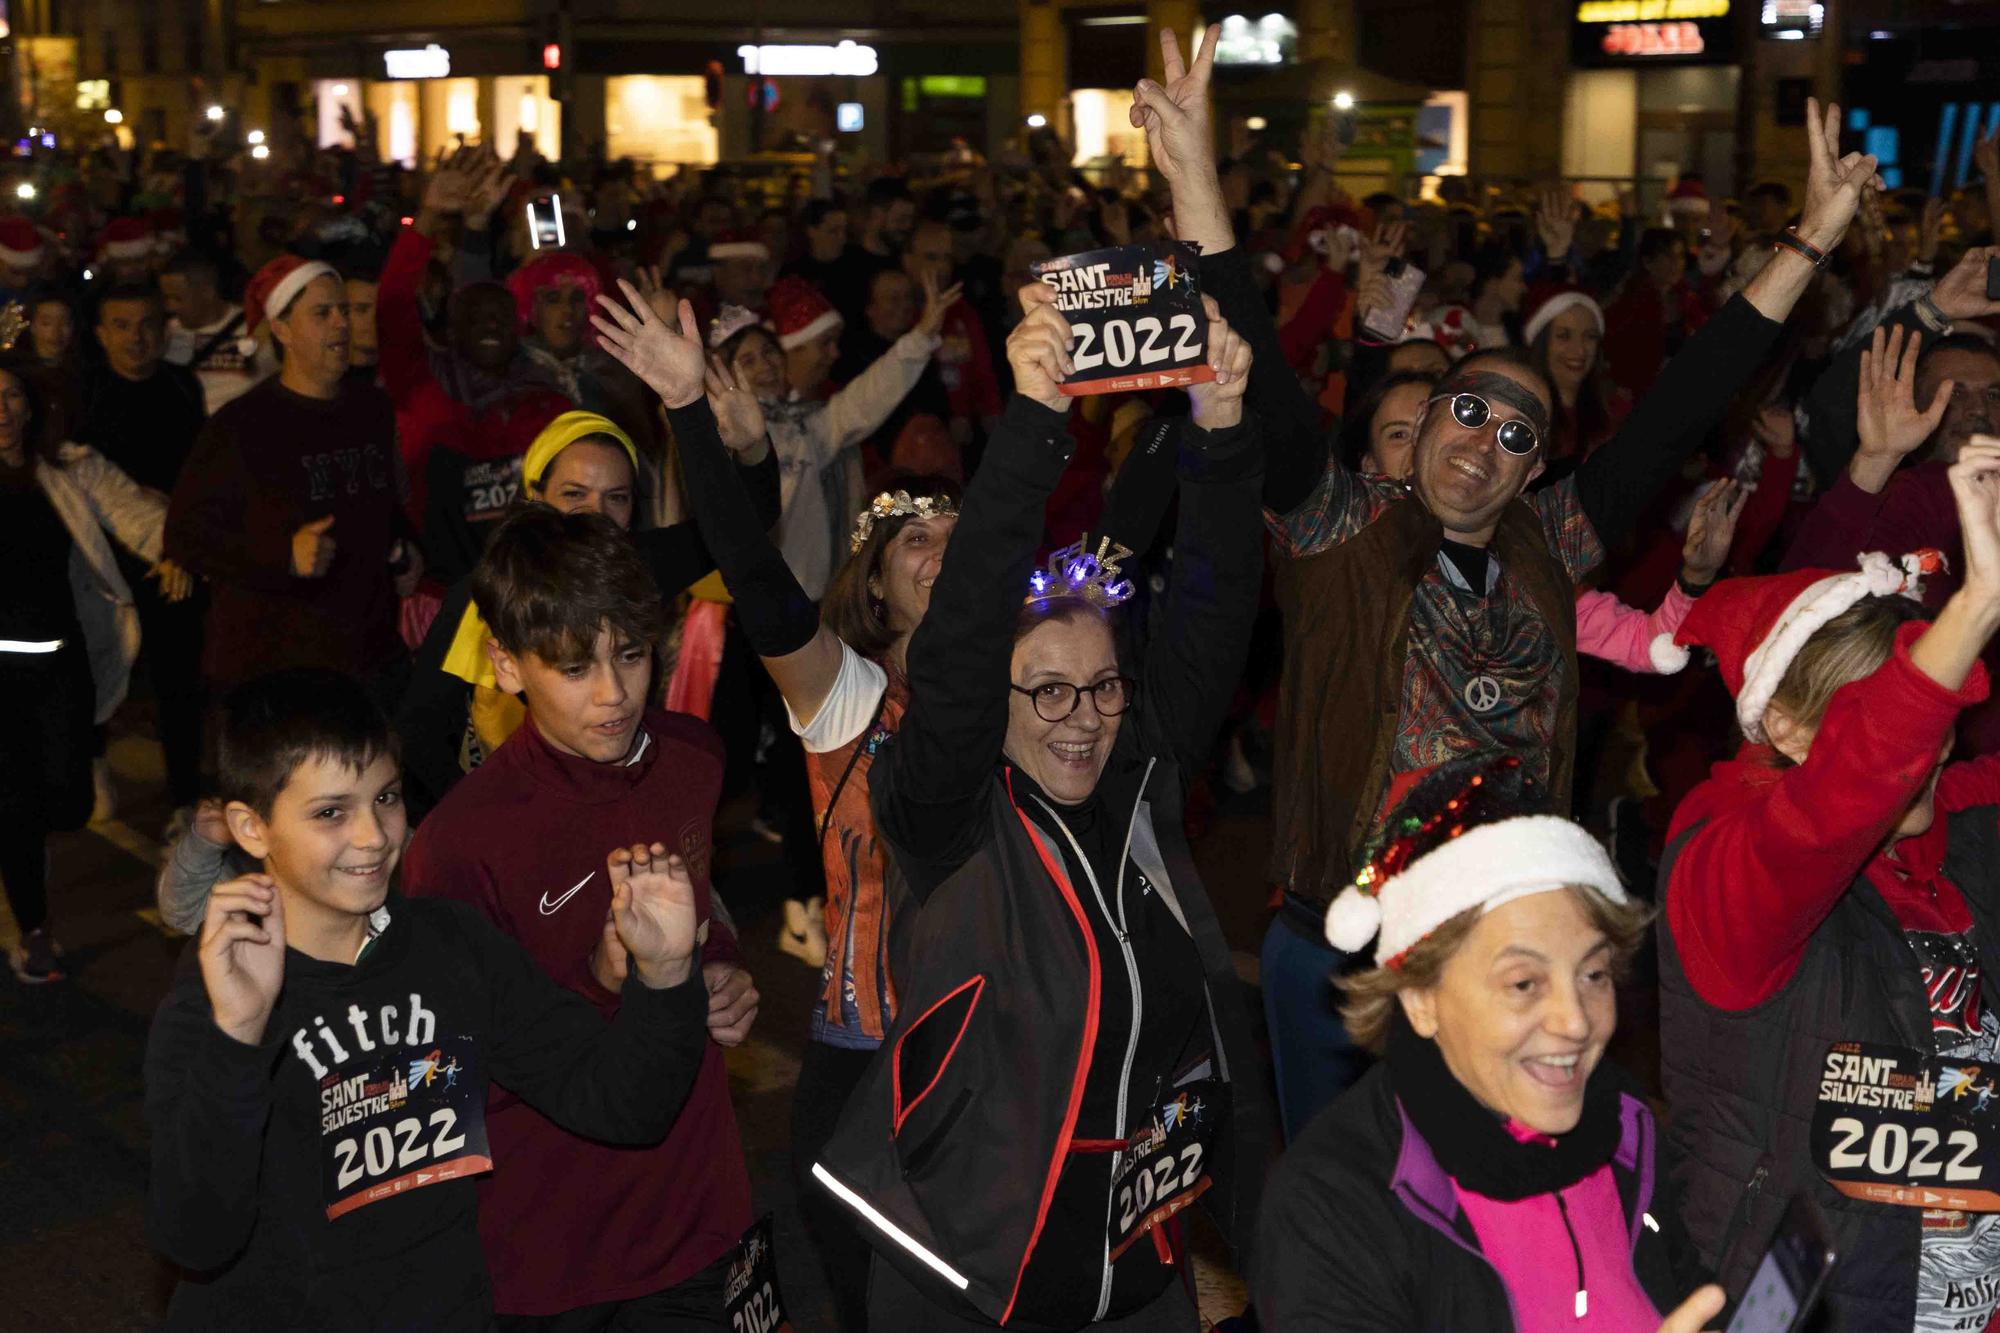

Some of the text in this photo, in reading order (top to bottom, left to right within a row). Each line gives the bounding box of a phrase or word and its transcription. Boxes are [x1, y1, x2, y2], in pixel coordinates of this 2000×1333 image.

[1042, 263, 1110, 292] SANT
[1071, 314, 1202, 371] 2022
[293, 993, 436, 1080] fitch
[1824, 1052, 1897, 1086] SANT
[321, 1073, 369, 1115] SANT
[322, 1092, 389, 1135] SiLVESTRE
[1819, 1080, 1916, 1111] SiLVESTRE
[334, 1108, 466, 1191] 2022
[1830, 1117, 1983, 1182] 2022
[1120, 1142, 1203, 1234] 2022
[1944, 1274, 2000, 1309] Holi
[1953, 1313, 1986, 1331] are
